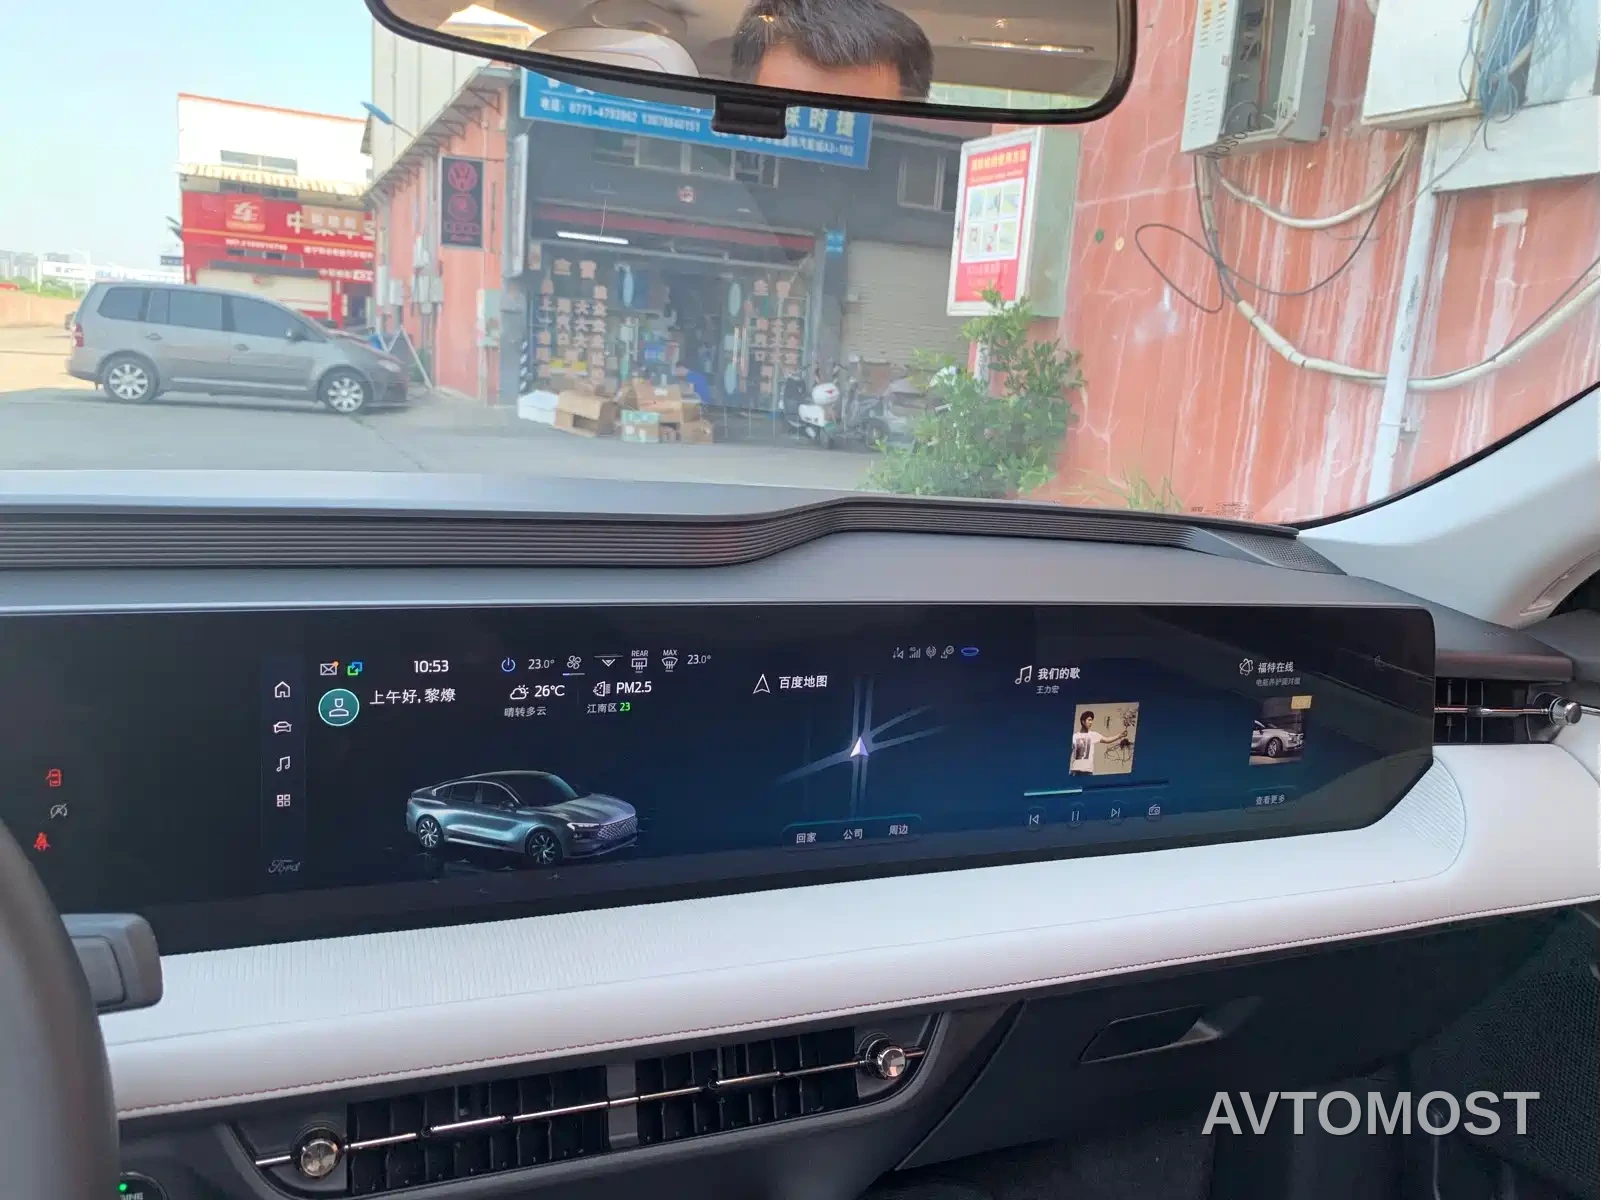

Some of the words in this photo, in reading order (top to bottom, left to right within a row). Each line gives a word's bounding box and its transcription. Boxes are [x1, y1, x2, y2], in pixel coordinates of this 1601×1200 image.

[413, 659, 449, 673] 10:53
[1258, 661, 1294, 674] 福特在线
[1038, 667, 1080, 680] 我们的歌
[616, 681, 652, 694] PM2.5
[779, 675, 828, 689] 百度地图
[1036, 685, 1060, 694] 王力宏
[504, 706, 547, 718] 晴转多云
[587, 703, 617, 714] 江南区
[619, 702, 631, 712] 23
[1256, 794, 1285, 805] 查看更多
[796, 832, 817, 844] 回家
[842, 828, 863, 840] 公司
[888, 824, 909, 836] 周边
[268, 859, 301, 874] Ford
